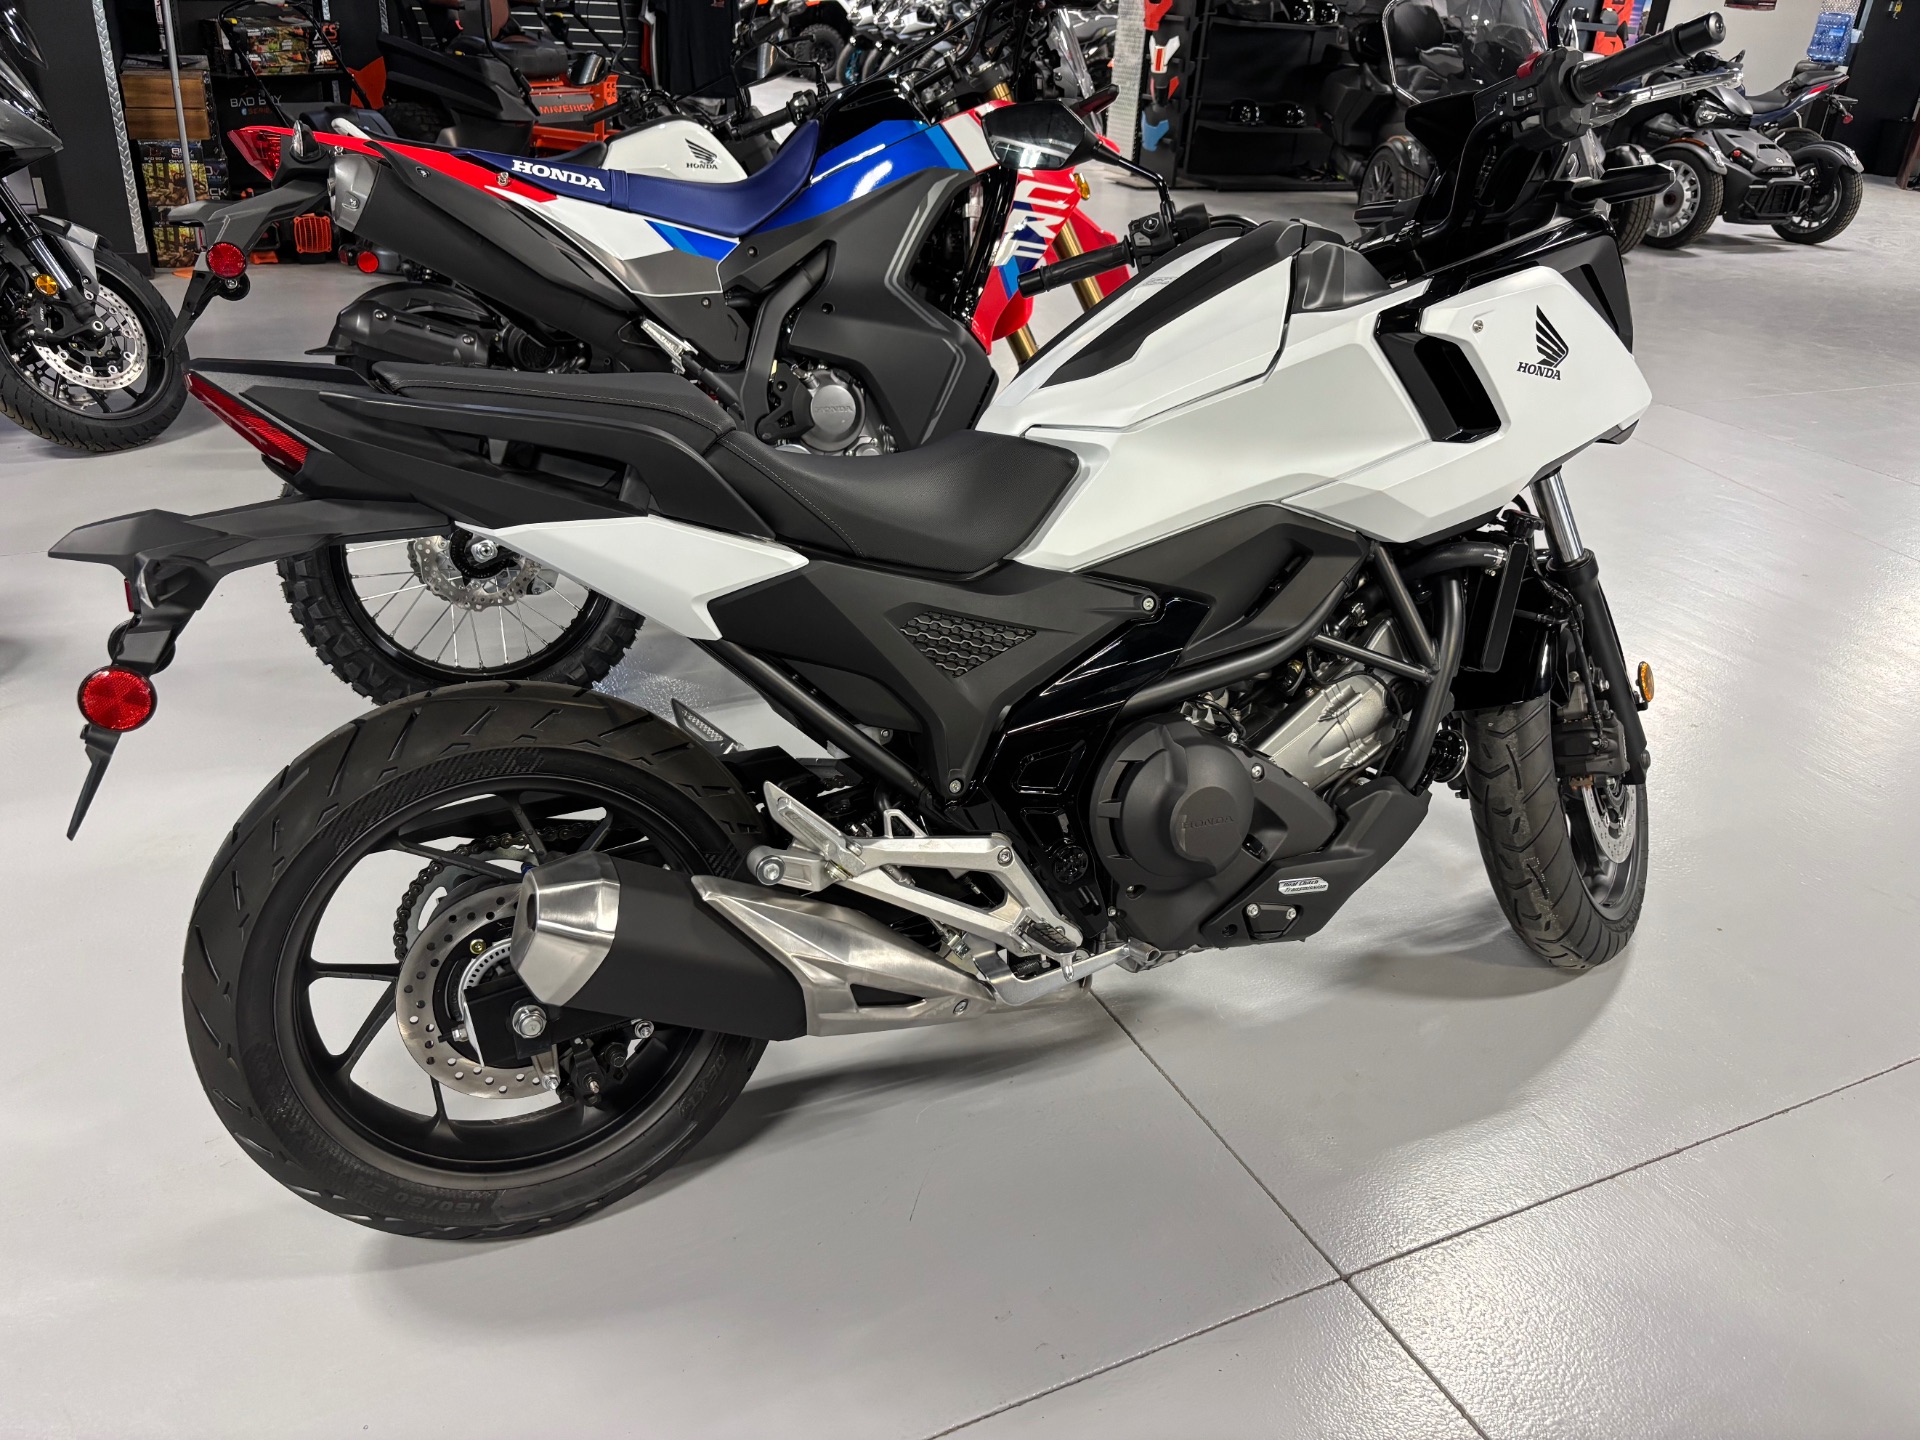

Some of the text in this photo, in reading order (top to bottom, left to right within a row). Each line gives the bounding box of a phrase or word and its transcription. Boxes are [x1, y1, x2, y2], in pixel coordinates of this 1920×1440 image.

[230, 97, 255, 107] BAD
[539, 103, 595, 114] MAVERICK
[685, 162, 719, 170] HONDA
[511, 159, 606, 192] HONDA
[1516, 361, 1561, 381] HONDA
[814, 405, 854, 413] HONDA
[1183, 815, 1235, 829] HONDA
